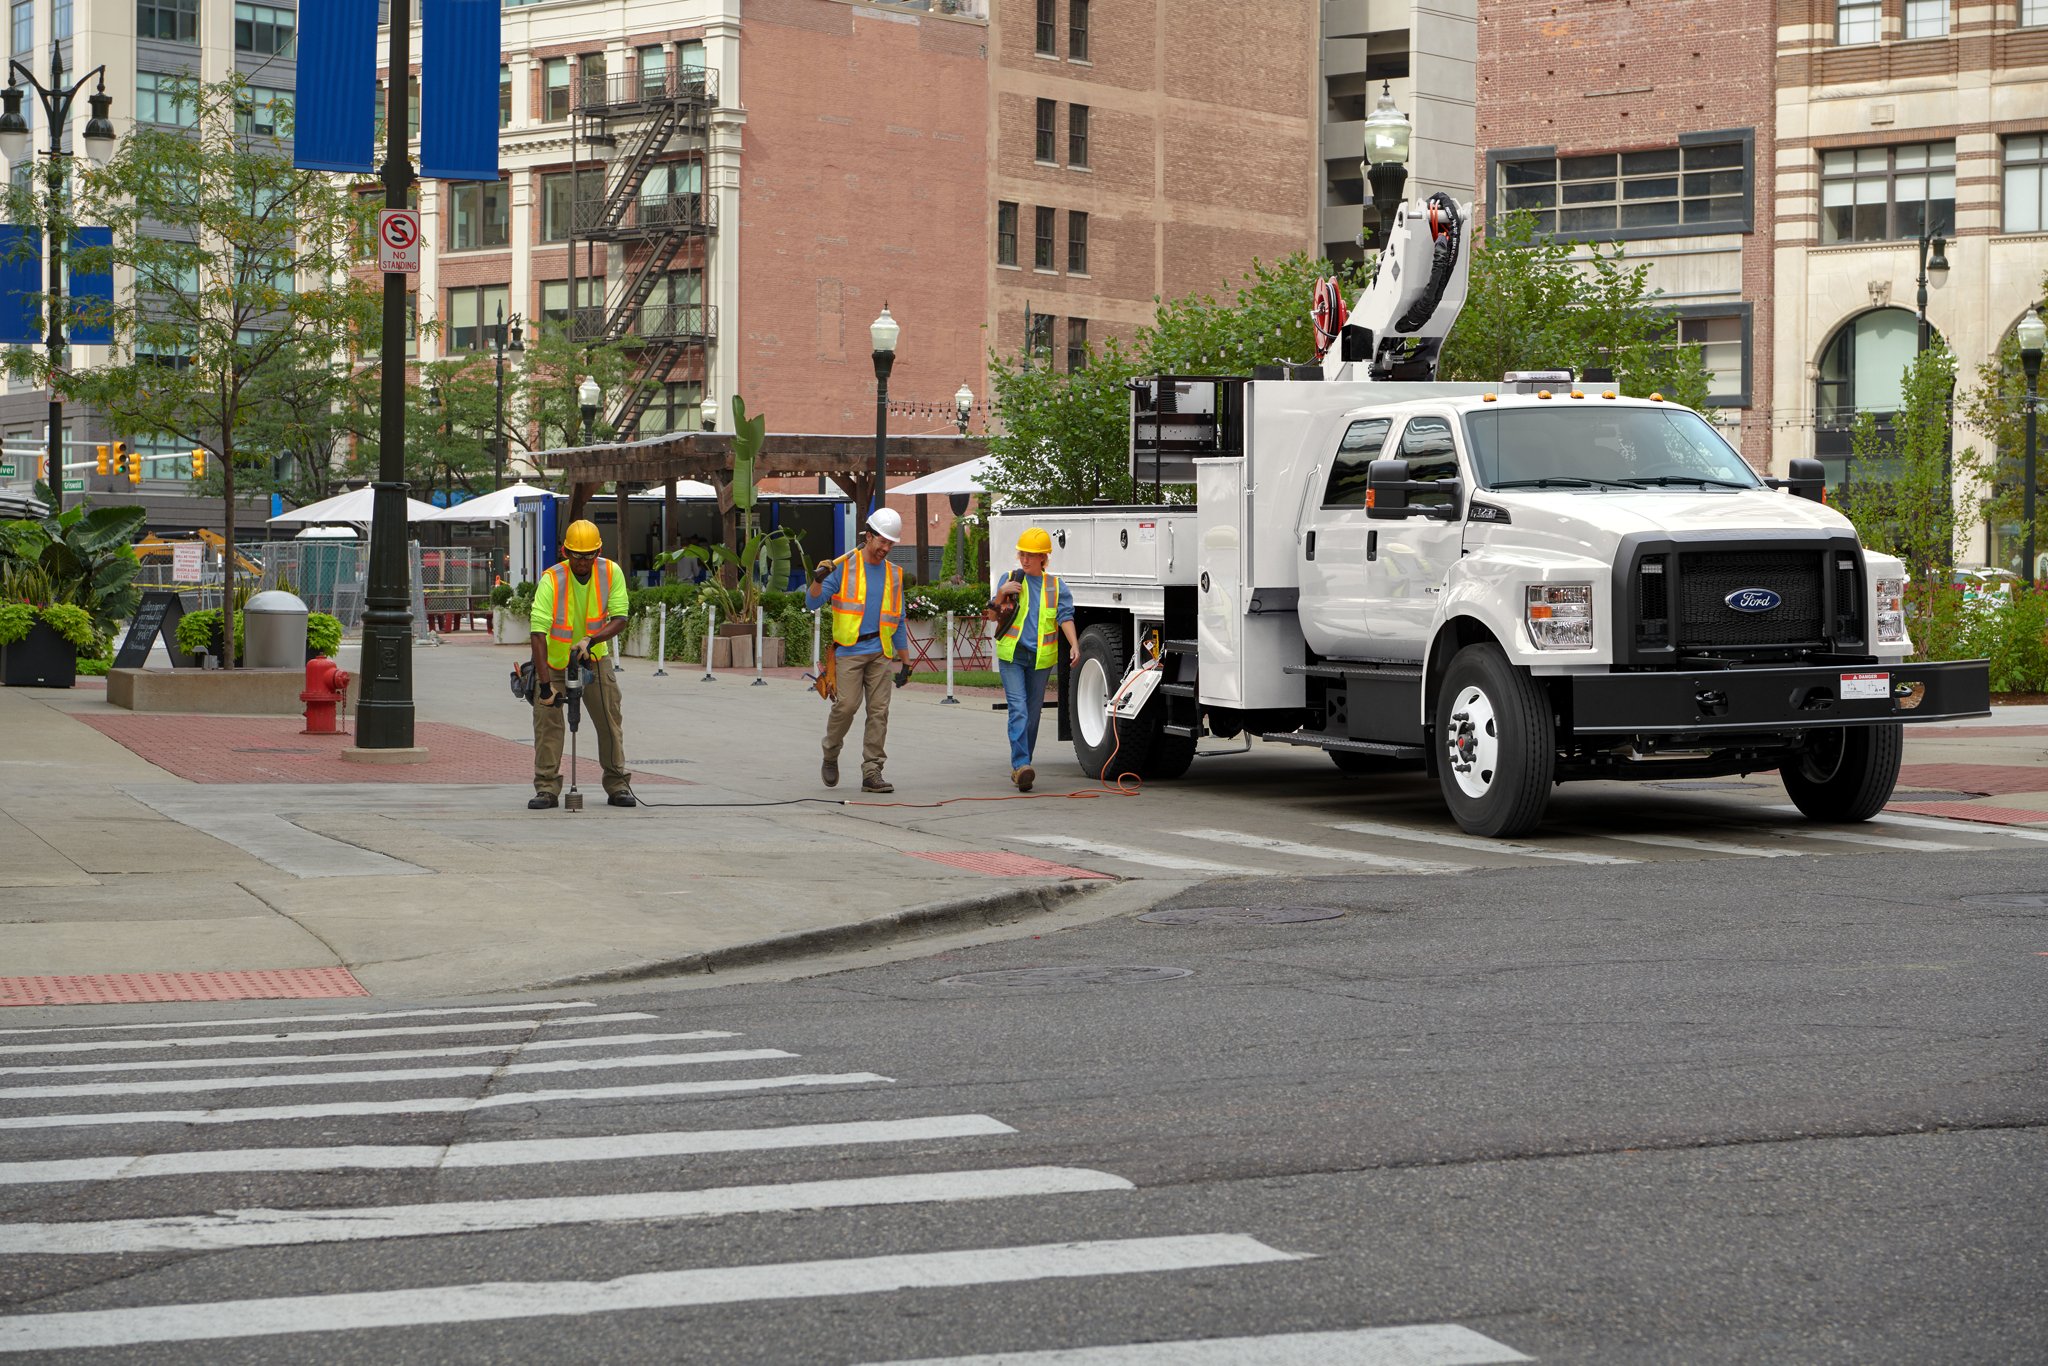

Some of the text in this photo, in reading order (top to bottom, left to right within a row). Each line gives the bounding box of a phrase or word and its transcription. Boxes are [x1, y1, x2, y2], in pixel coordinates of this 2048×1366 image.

[392, 251, 407, 260] NO
[382, 260, 417, 270] STANDING
[1740, 592, 1771, 607] Ford
